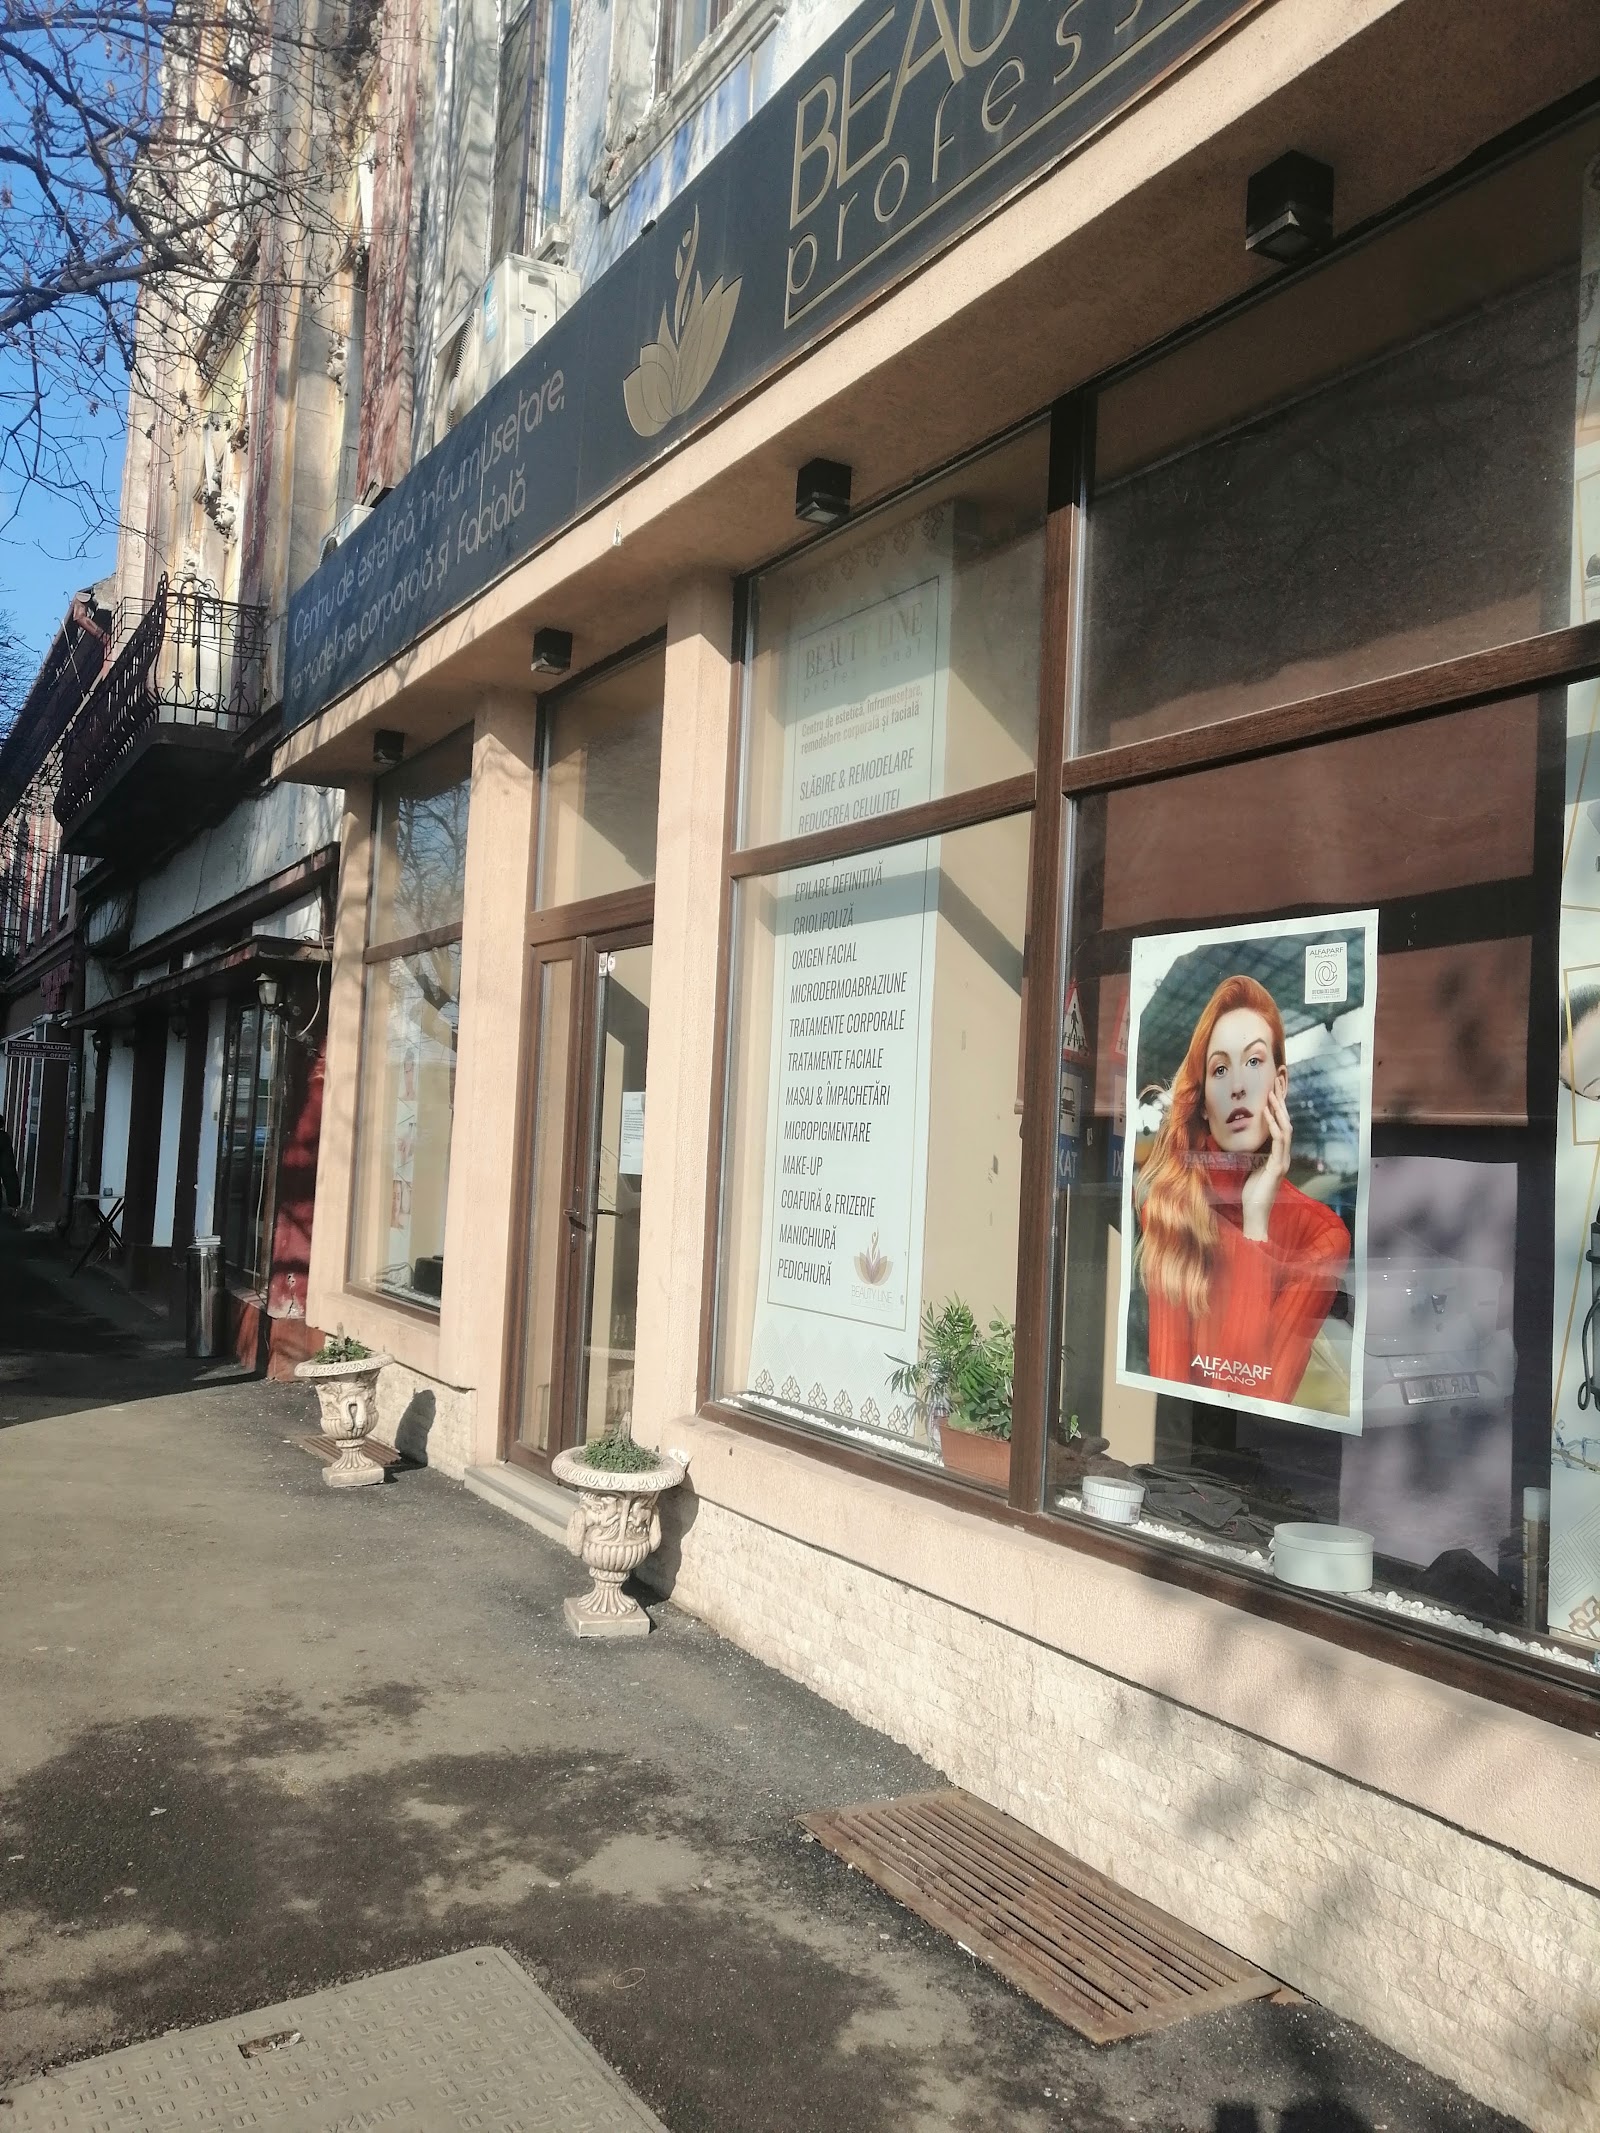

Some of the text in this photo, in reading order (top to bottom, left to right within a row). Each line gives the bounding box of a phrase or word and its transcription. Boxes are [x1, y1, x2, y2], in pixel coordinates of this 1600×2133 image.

[294, 586, 335, 647] Centru
[337, 562, 354, 606] de
[801, 719, 824, 738] Centru
[826, 714, 834, 729] de
[801, 731, 841, 755] remodelare
[800, 747, 915, 801] SLĂBIRE & REMODELARE
[798, 788, 900, 835] REDUCEREA CELULITEI
[794, 860, 883, 903] EPILARE DEFINITIVĂ
[793, 902, 854, 936] CRIOLIPOLIZĂ
[791, 941, 858, 970] OXIGEN FACIAL
[1309, 947, 1344, 956] ALFAPARF
[790, 971, 908, 1004] MICRODERMOABRAZIUNE
[789, 1009, 906, 1038] TRATAMENTE CORPORALE
[788, 1048, 884, 1072] TRATAMENTE FACIALE
[785, 1080, 890, 1106] MASAJ & ÎMPACHETĂRI
[783, 1120, 872, 1142] MICROPIGMENTARE
[782, 1155, 823, 1176] MAKE-UP
[781, 1188, 876, 1218] COAFURĂ & FRIZERIE
[779, 1224, 837, 1250] MANICHIURĂ
[777, 1258, 832, 1286] PEDICHIURĂ
[1191, 1354, 1272, 1381] ALFAPARF
[1203, 1370, 1257, 1387] MILANO
